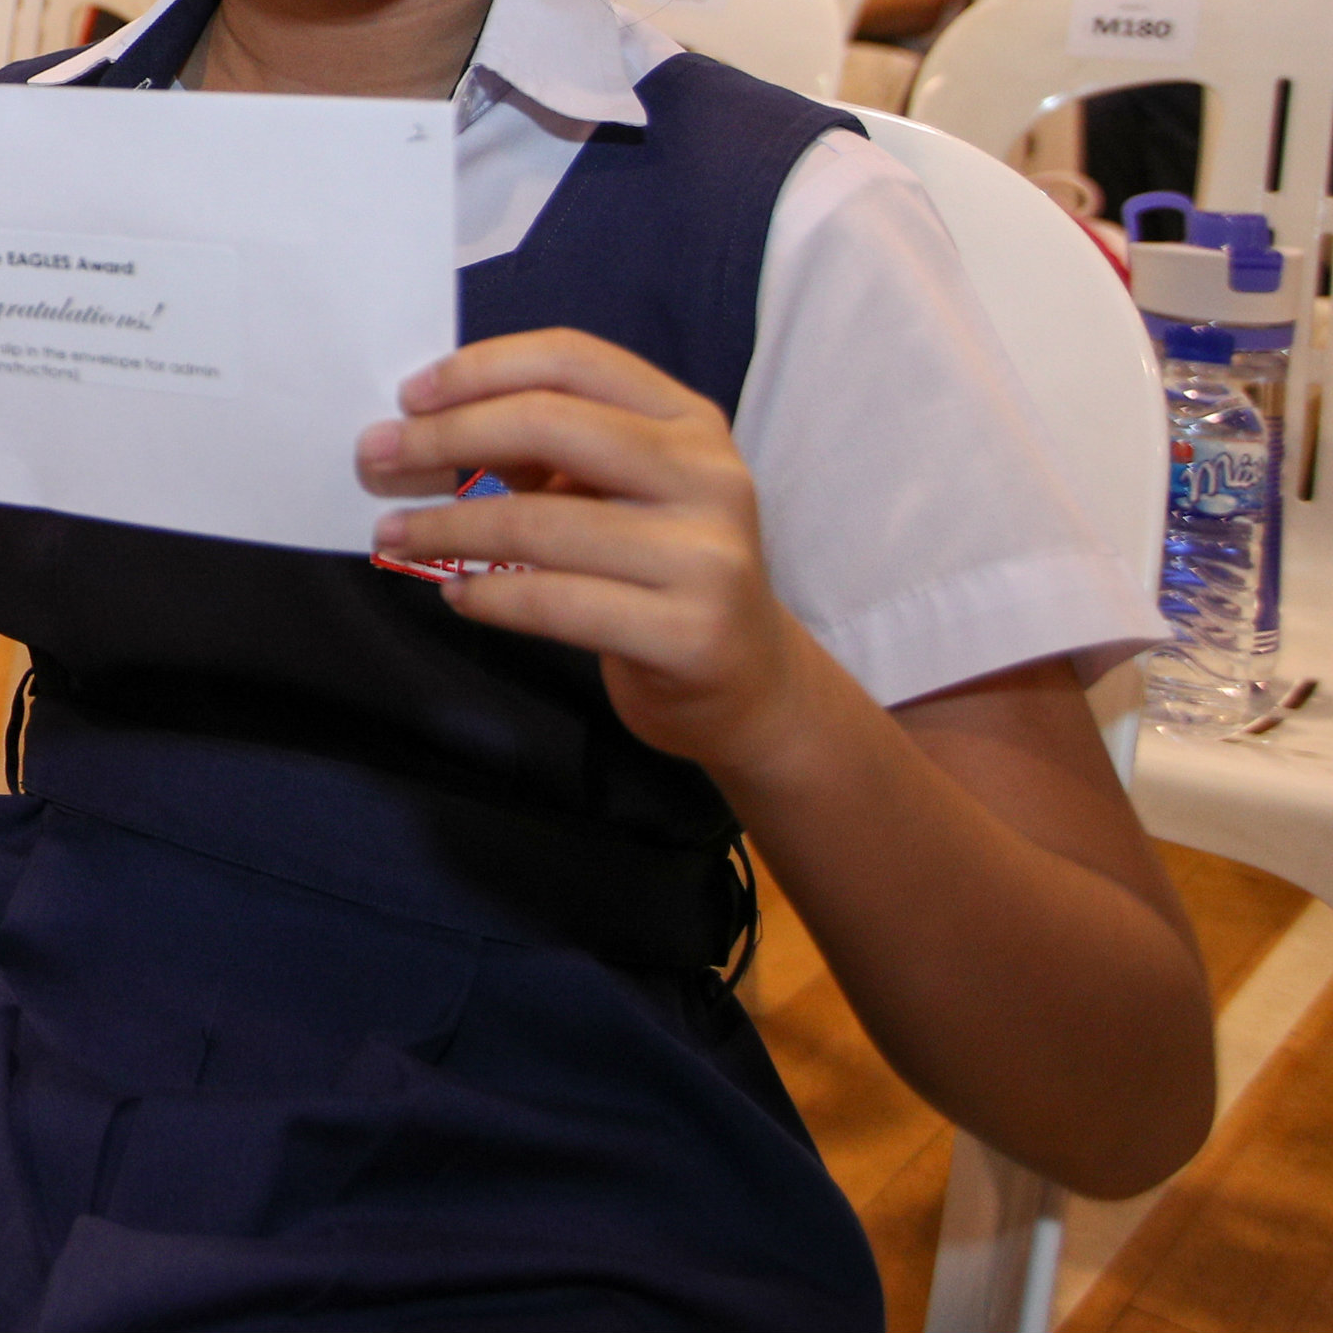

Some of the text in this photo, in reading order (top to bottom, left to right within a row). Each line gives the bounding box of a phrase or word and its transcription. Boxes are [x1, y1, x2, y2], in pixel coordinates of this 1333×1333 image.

[1093, 18, 1173, 39] M180
[6, 250, 71, 270] EAGLES
[76, 255, 135, 275] Award
